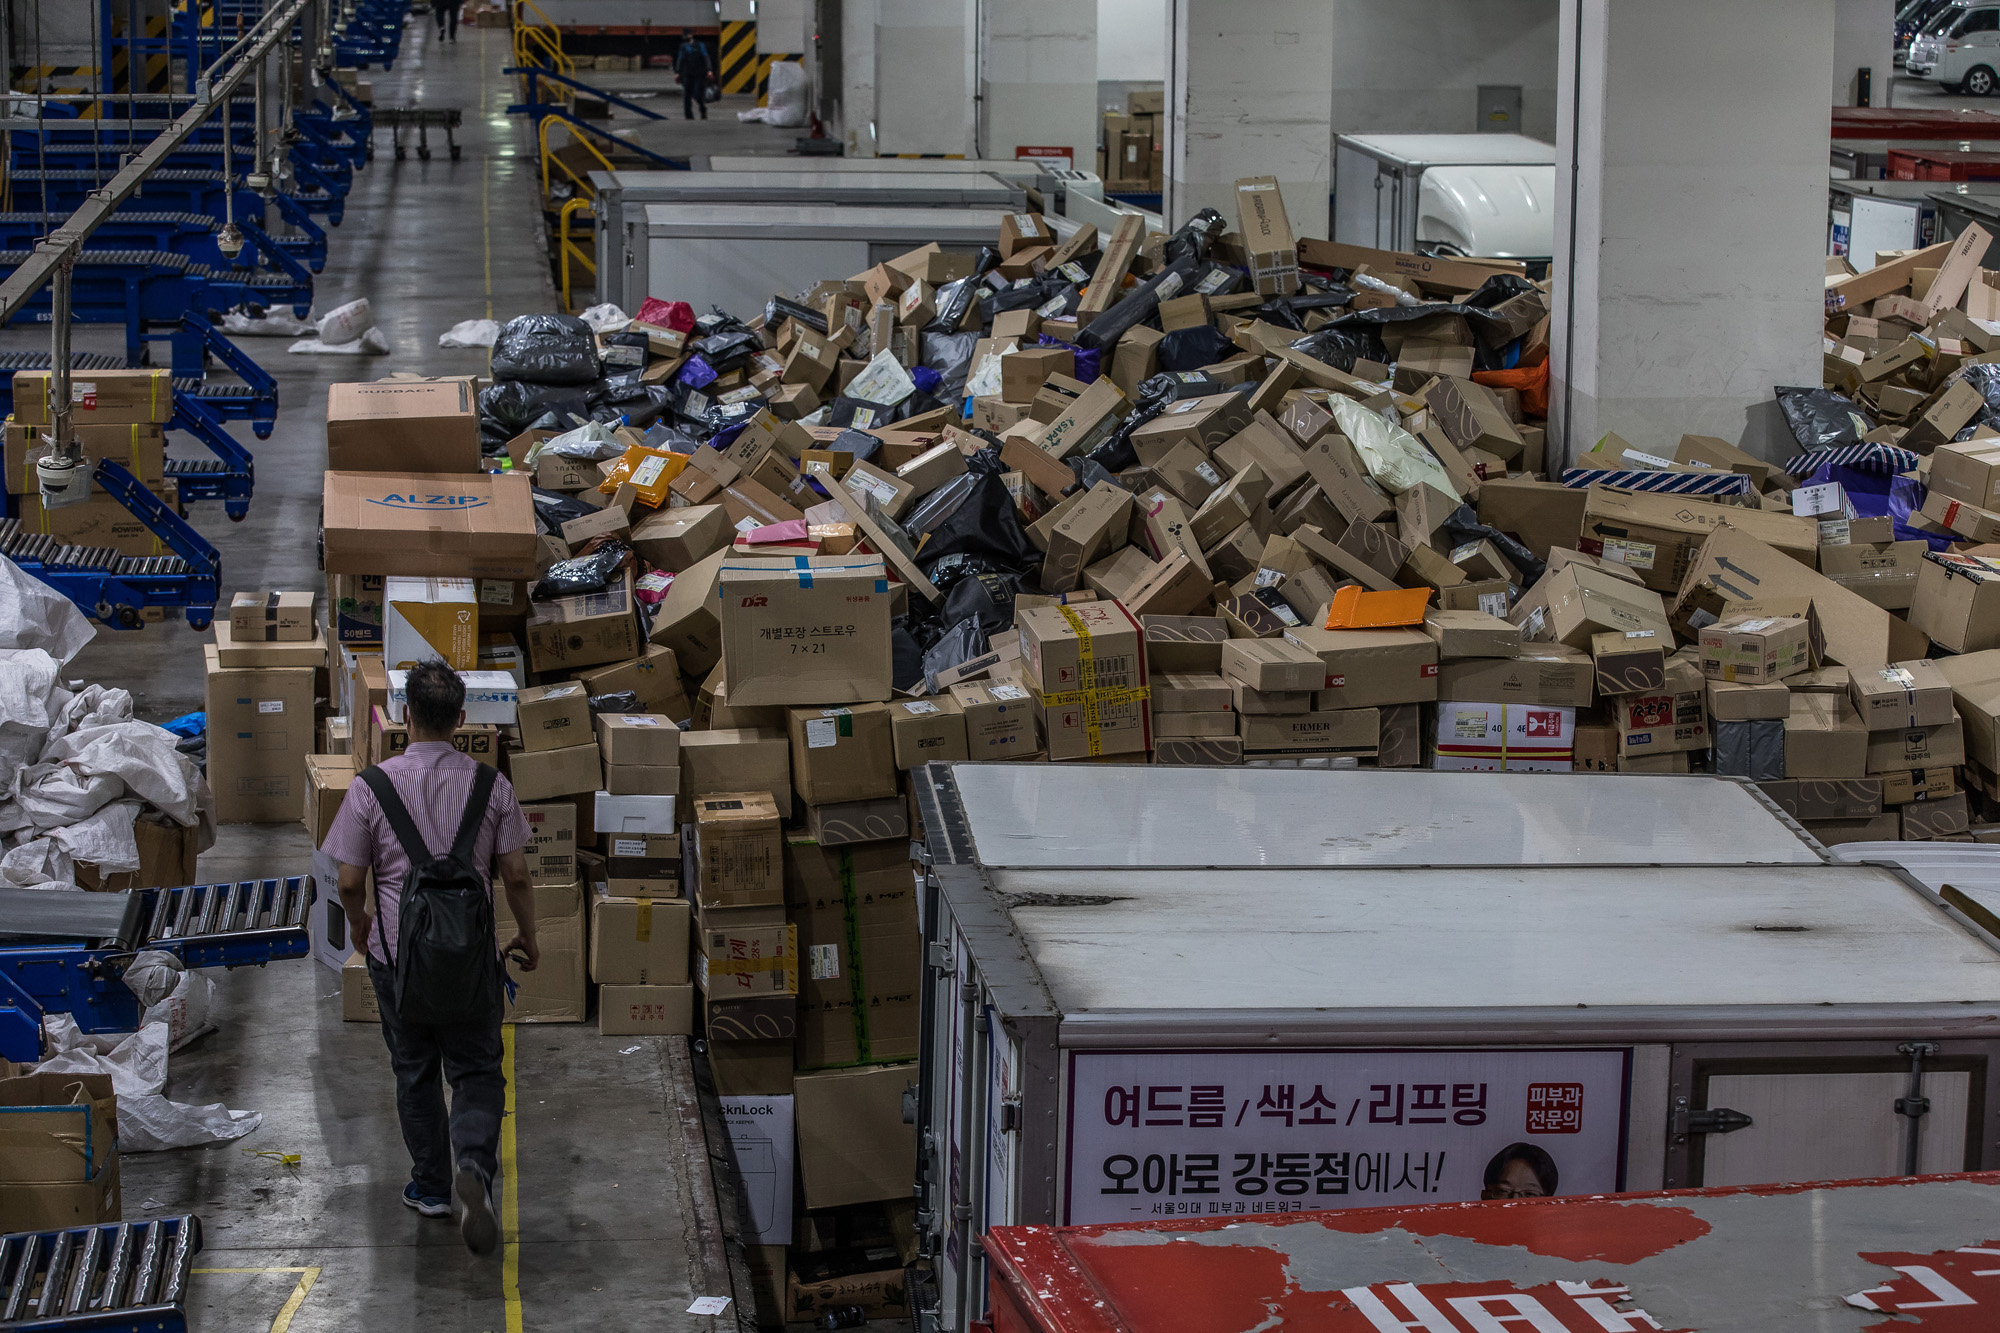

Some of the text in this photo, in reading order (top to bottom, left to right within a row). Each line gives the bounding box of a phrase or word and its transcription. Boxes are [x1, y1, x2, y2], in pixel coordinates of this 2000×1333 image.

[344, 629, 372, 639] 50밴드
[760, 624, 857, 640] 개별포장 스트로우
[790, 643, 798, 654] 7
[812, 643, 826, 654] 21
[1292, 722, 1331, 731] ERMER
[1904, 752, 1931, 761] 취급주의
[1529, 1086, 1582, 1107] 피부과
[1529, 1109, 1580, 1131] 전문의
[1101, 1151, 1445, 1195] 오아로 강동점에서!
[1151, 1201, 1302, 1214] 서울의대 피부과 네트워크
